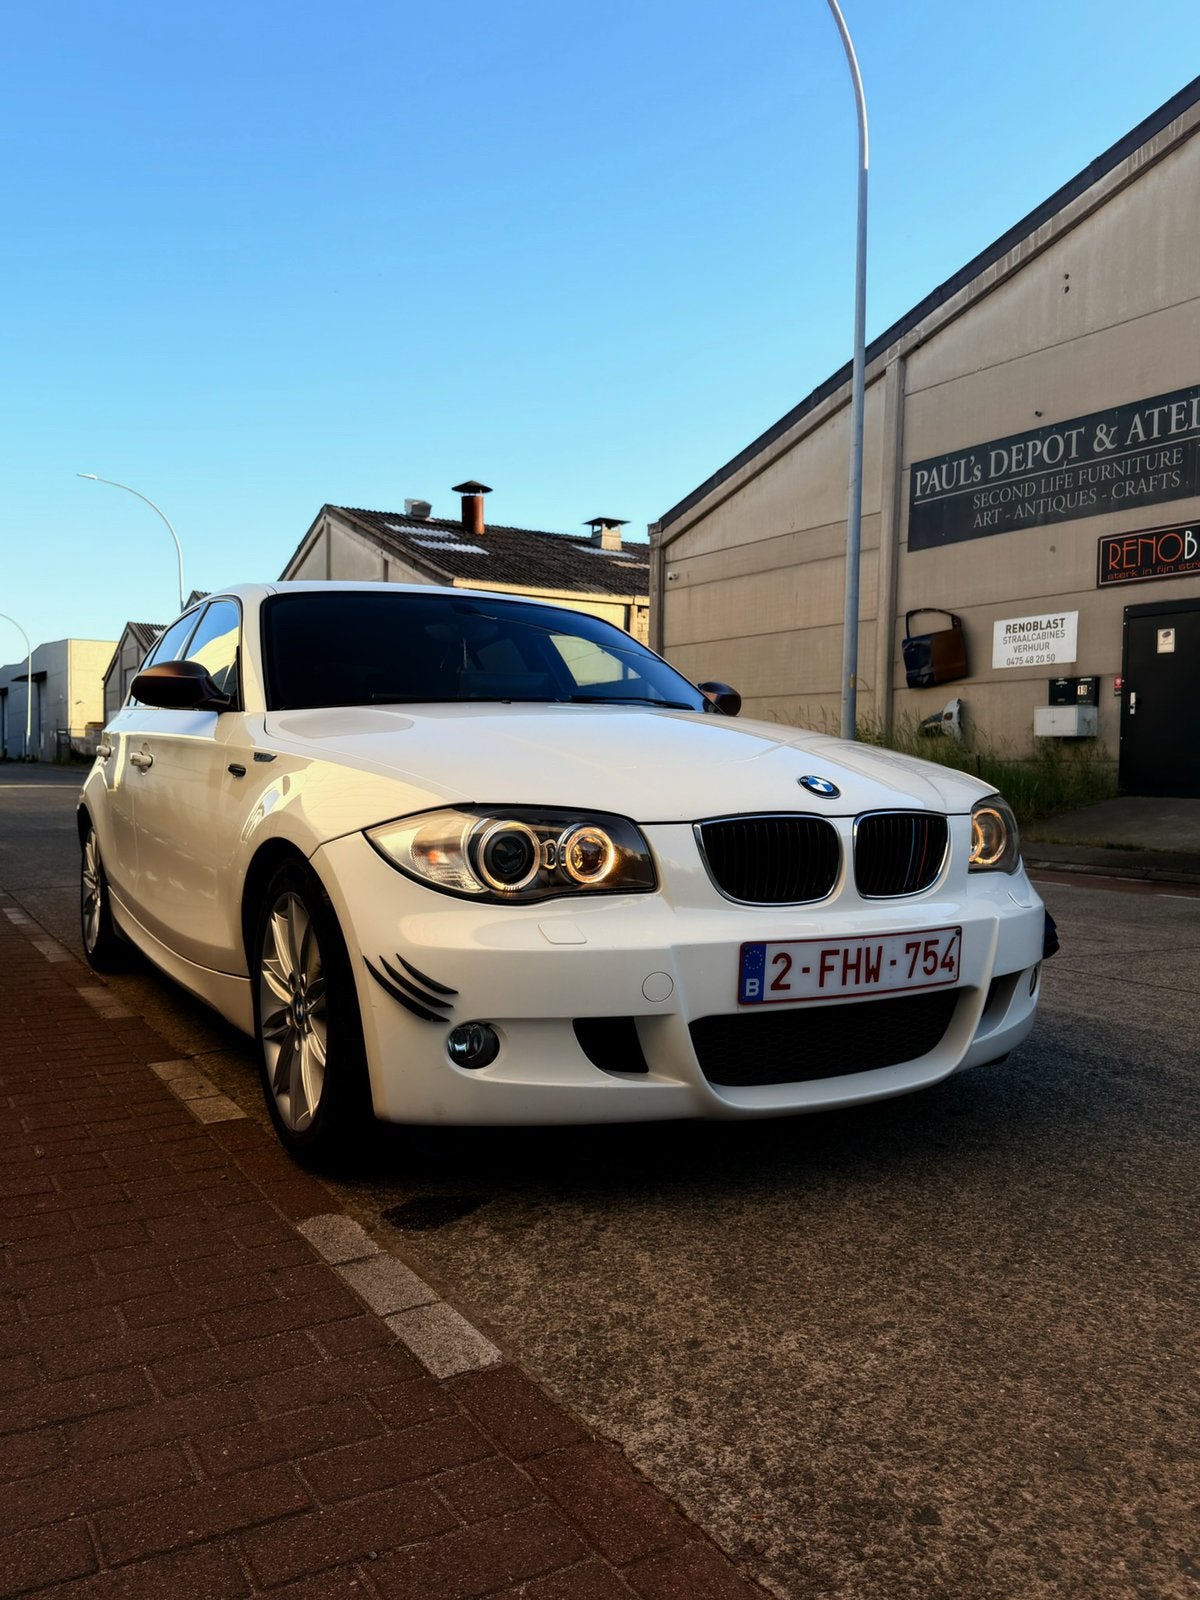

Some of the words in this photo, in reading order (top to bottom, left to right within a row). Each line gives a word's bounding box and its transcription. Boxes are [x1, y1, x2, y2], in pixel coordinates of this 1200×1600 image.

[915, 456, 982, 497] PAUL's
[988, 427, 1085, 478] DEPOT
[1093, 423, 1118, 452] &
[973, 481, 1036, 510] SECOND
[1041, 473, 1074, 494] LIFE
[1078, 448, 1183, 486] FURNITURE
[973, 508, 1002, 528] ART
[1014, 488, 1097, 519] ANTIQUES
[1111, 470, 1181, 499] CRAFTS
[1005, 618, 1066, 634] RENOBLAST
[1002, 629, 1066, 645] STRAALCABINES
[1013, 642, 1050, 653] VERHUUR
[1006, 656, 1024, 666] 0475
[1025, 655, 1034, 664] 48
[1036, 654, 1045, 663] 20
[1046, 653, 1056, 662] 50
[770, 936, 957, 991] 2-FHW-754
[745, 978, 760, 997] B
